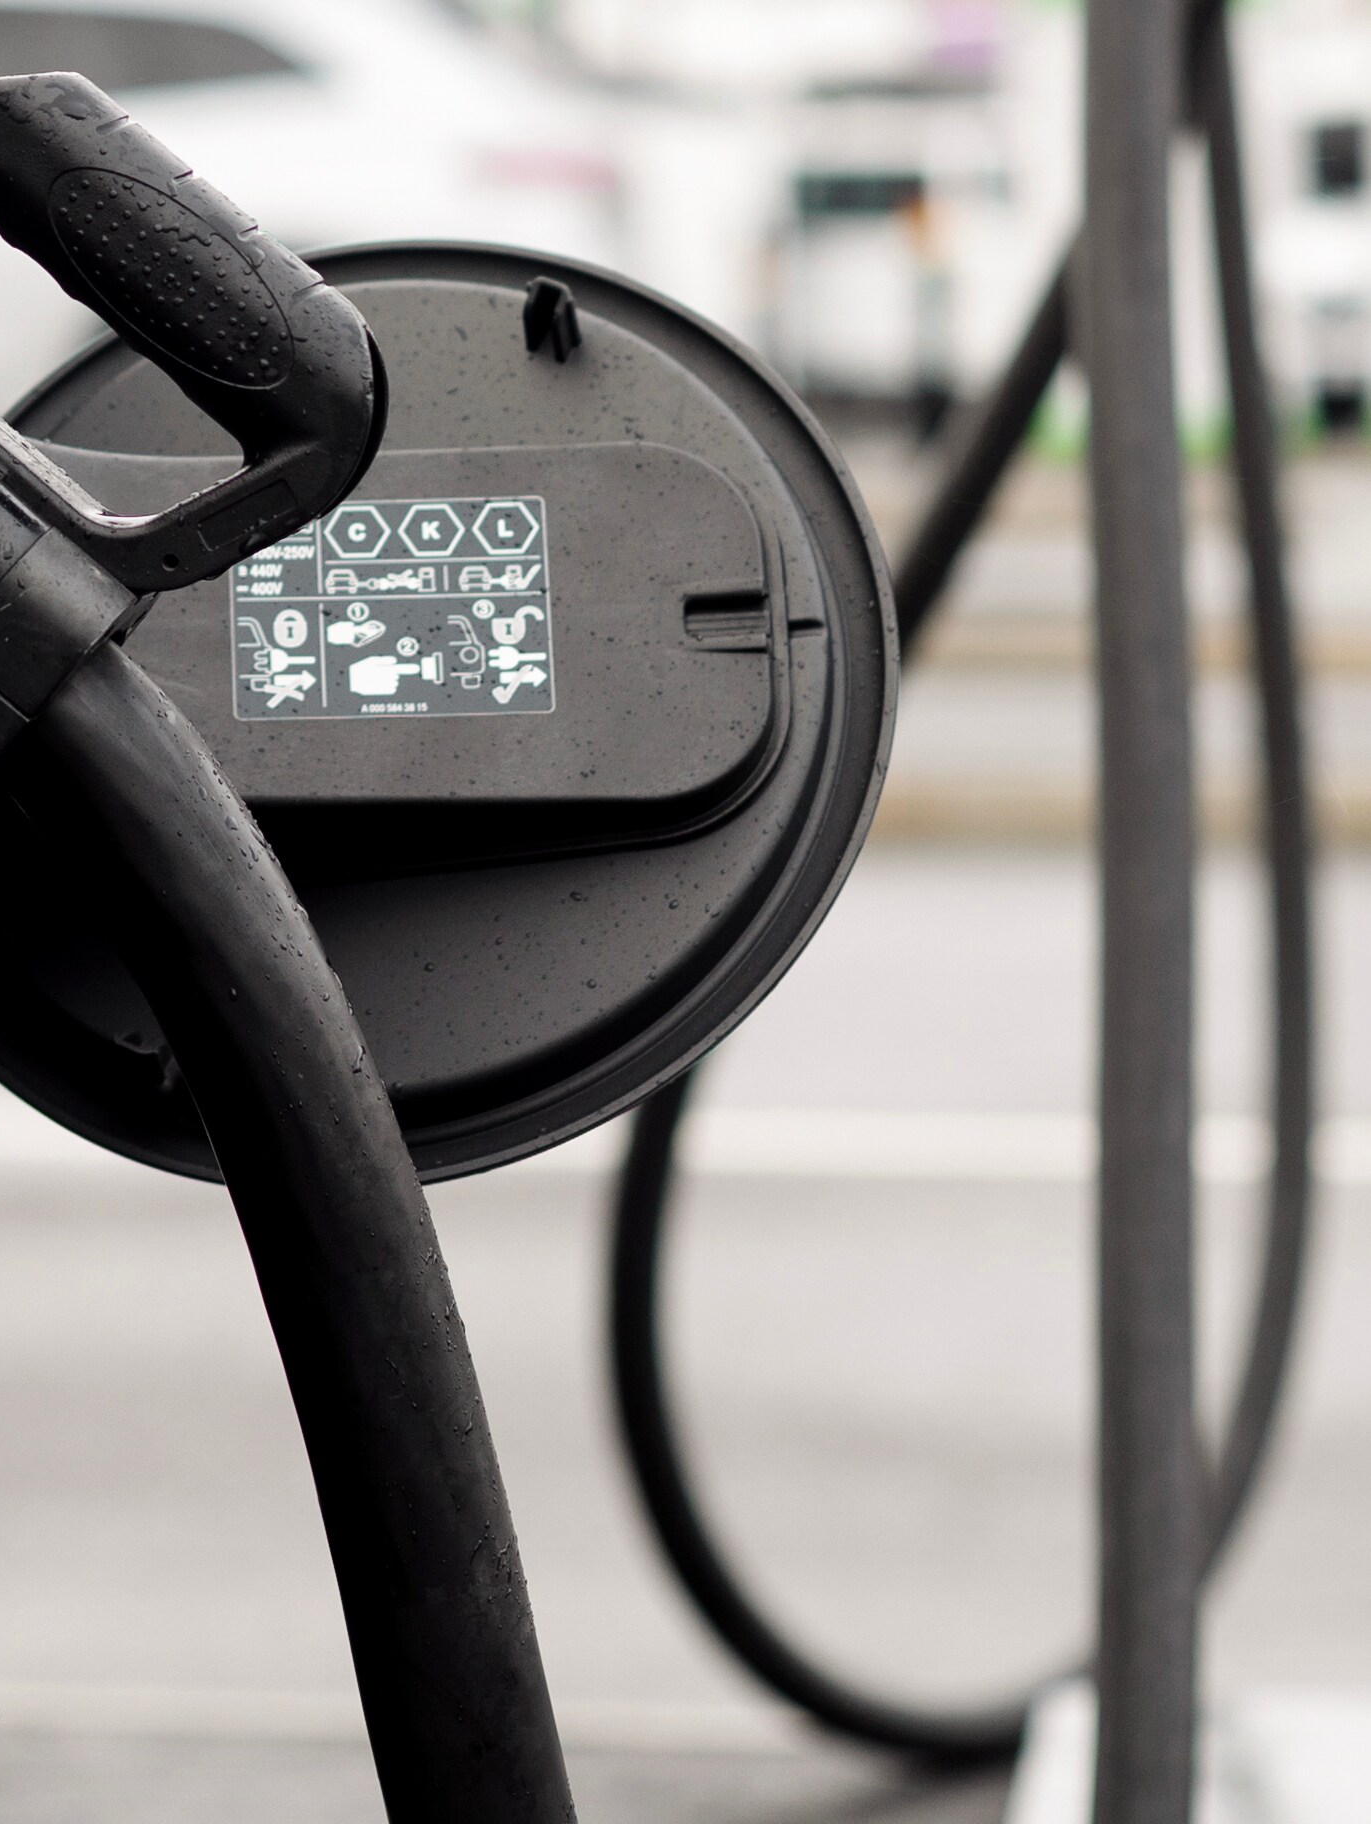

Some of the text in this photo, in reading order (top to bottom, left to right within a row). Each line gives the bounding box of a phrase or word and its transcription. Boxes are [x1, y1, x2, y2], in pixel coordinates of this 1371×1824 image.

[348, 518, 514, 542] C K L
[249, 563, 283, 578] 440V
[250, 581, 283, 595] 400V
[360, 703, 369, 713] A
